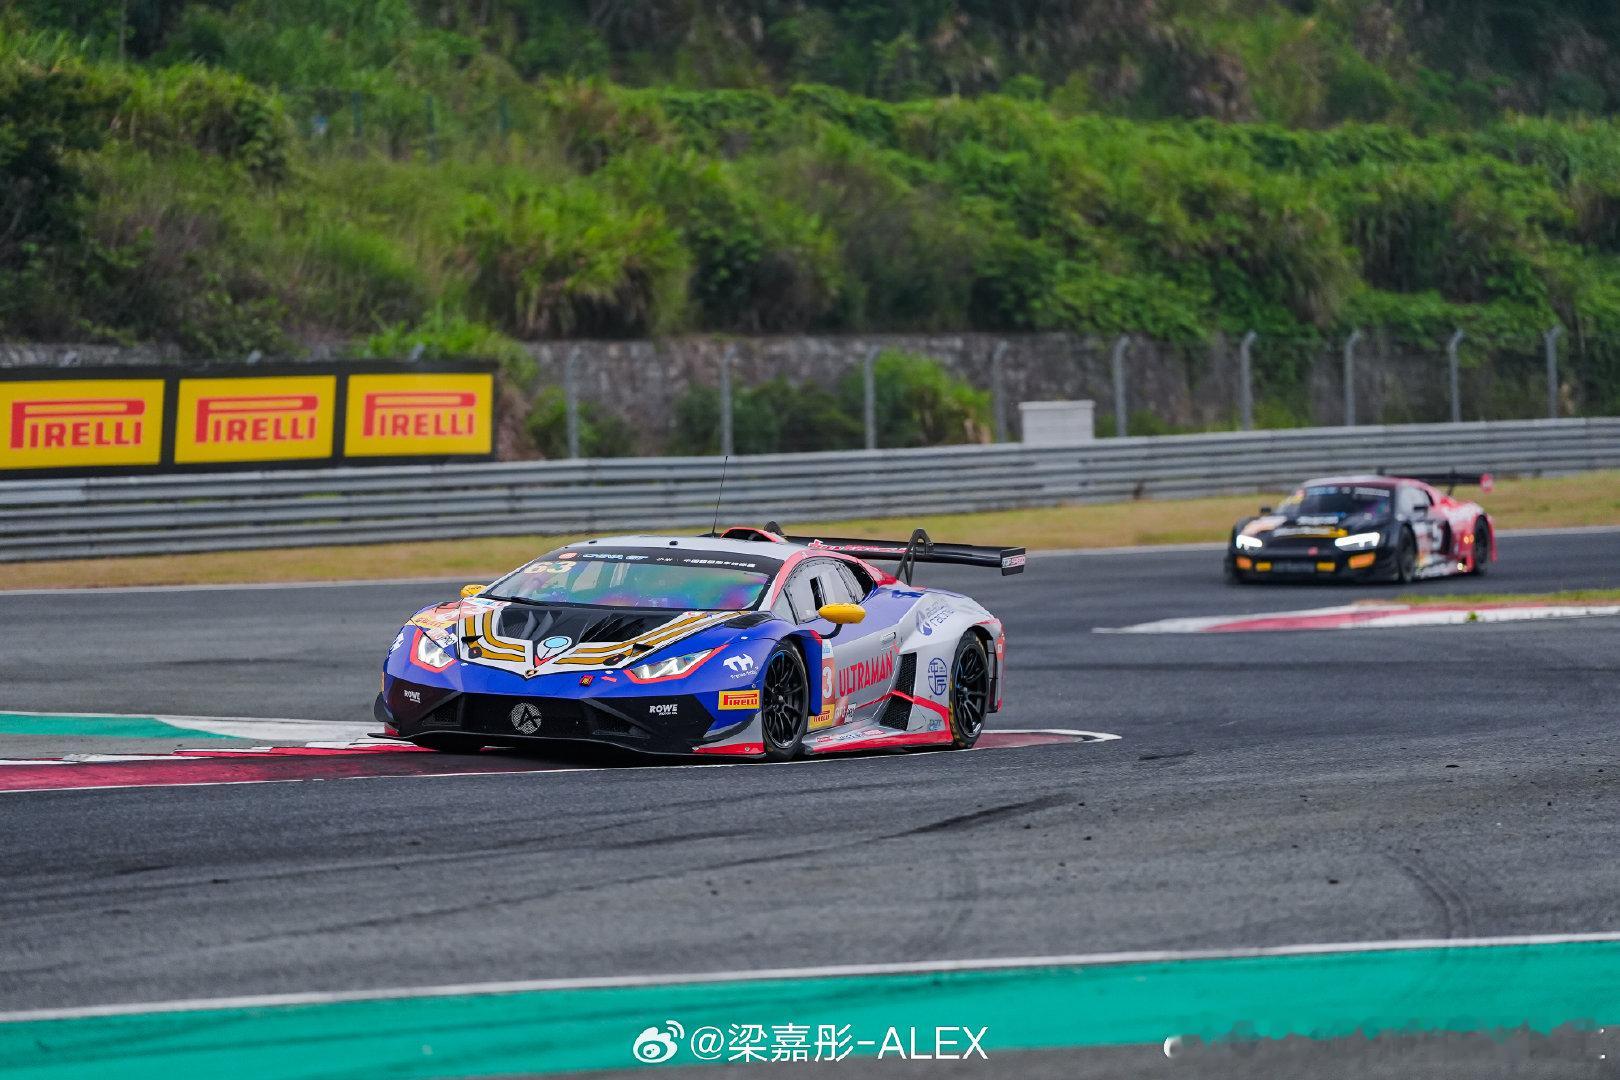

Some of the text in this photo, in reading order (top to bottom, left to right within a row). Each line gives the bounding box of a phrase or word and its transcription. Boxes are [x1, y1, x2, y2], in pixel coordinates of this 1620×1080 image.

[10, 399, 145, 449] PIRELLI
[195, 395, 318, 443] PIRELLI
[363, 392, 476, 437] PIRELLI
[403, 690, 421, 700] ROWE
[839, 650, 893, 697] ULTRAMAN
[649, 704, 678, 713] ROWE
[723, 693, 758, 706] PIRELLI
